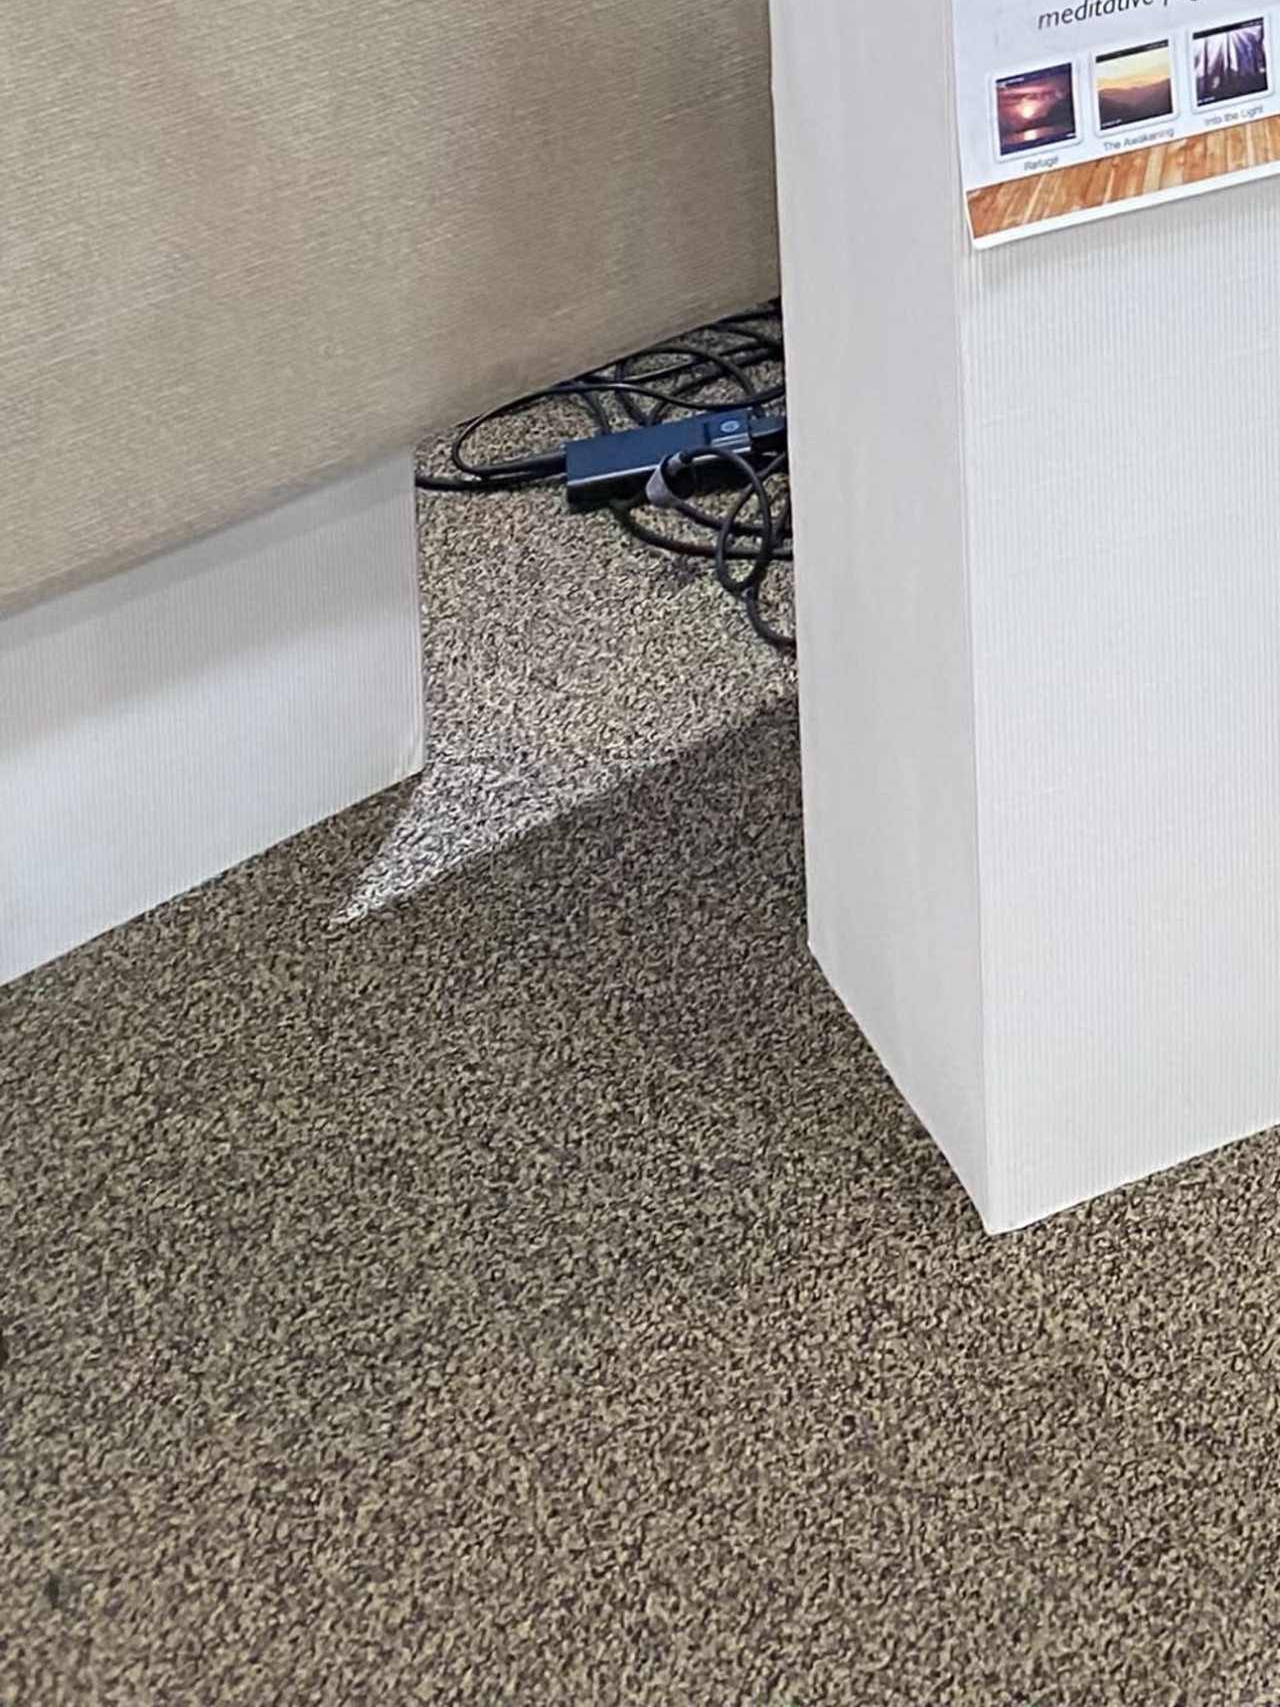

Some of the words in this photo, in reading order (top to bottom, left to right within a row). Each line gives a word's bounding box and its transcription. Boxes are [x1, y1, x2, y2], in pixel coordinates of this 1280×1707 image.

[1204, 115, 1223, 127] Into
[1224, 111, 1239, 123] the
[1241, 104, 1264, 120] Light
[1103, 139, 1121, 152] The
[1123, 128, 1175, 147] Awakening
[1023, 156, 1059, 171] Refuge
